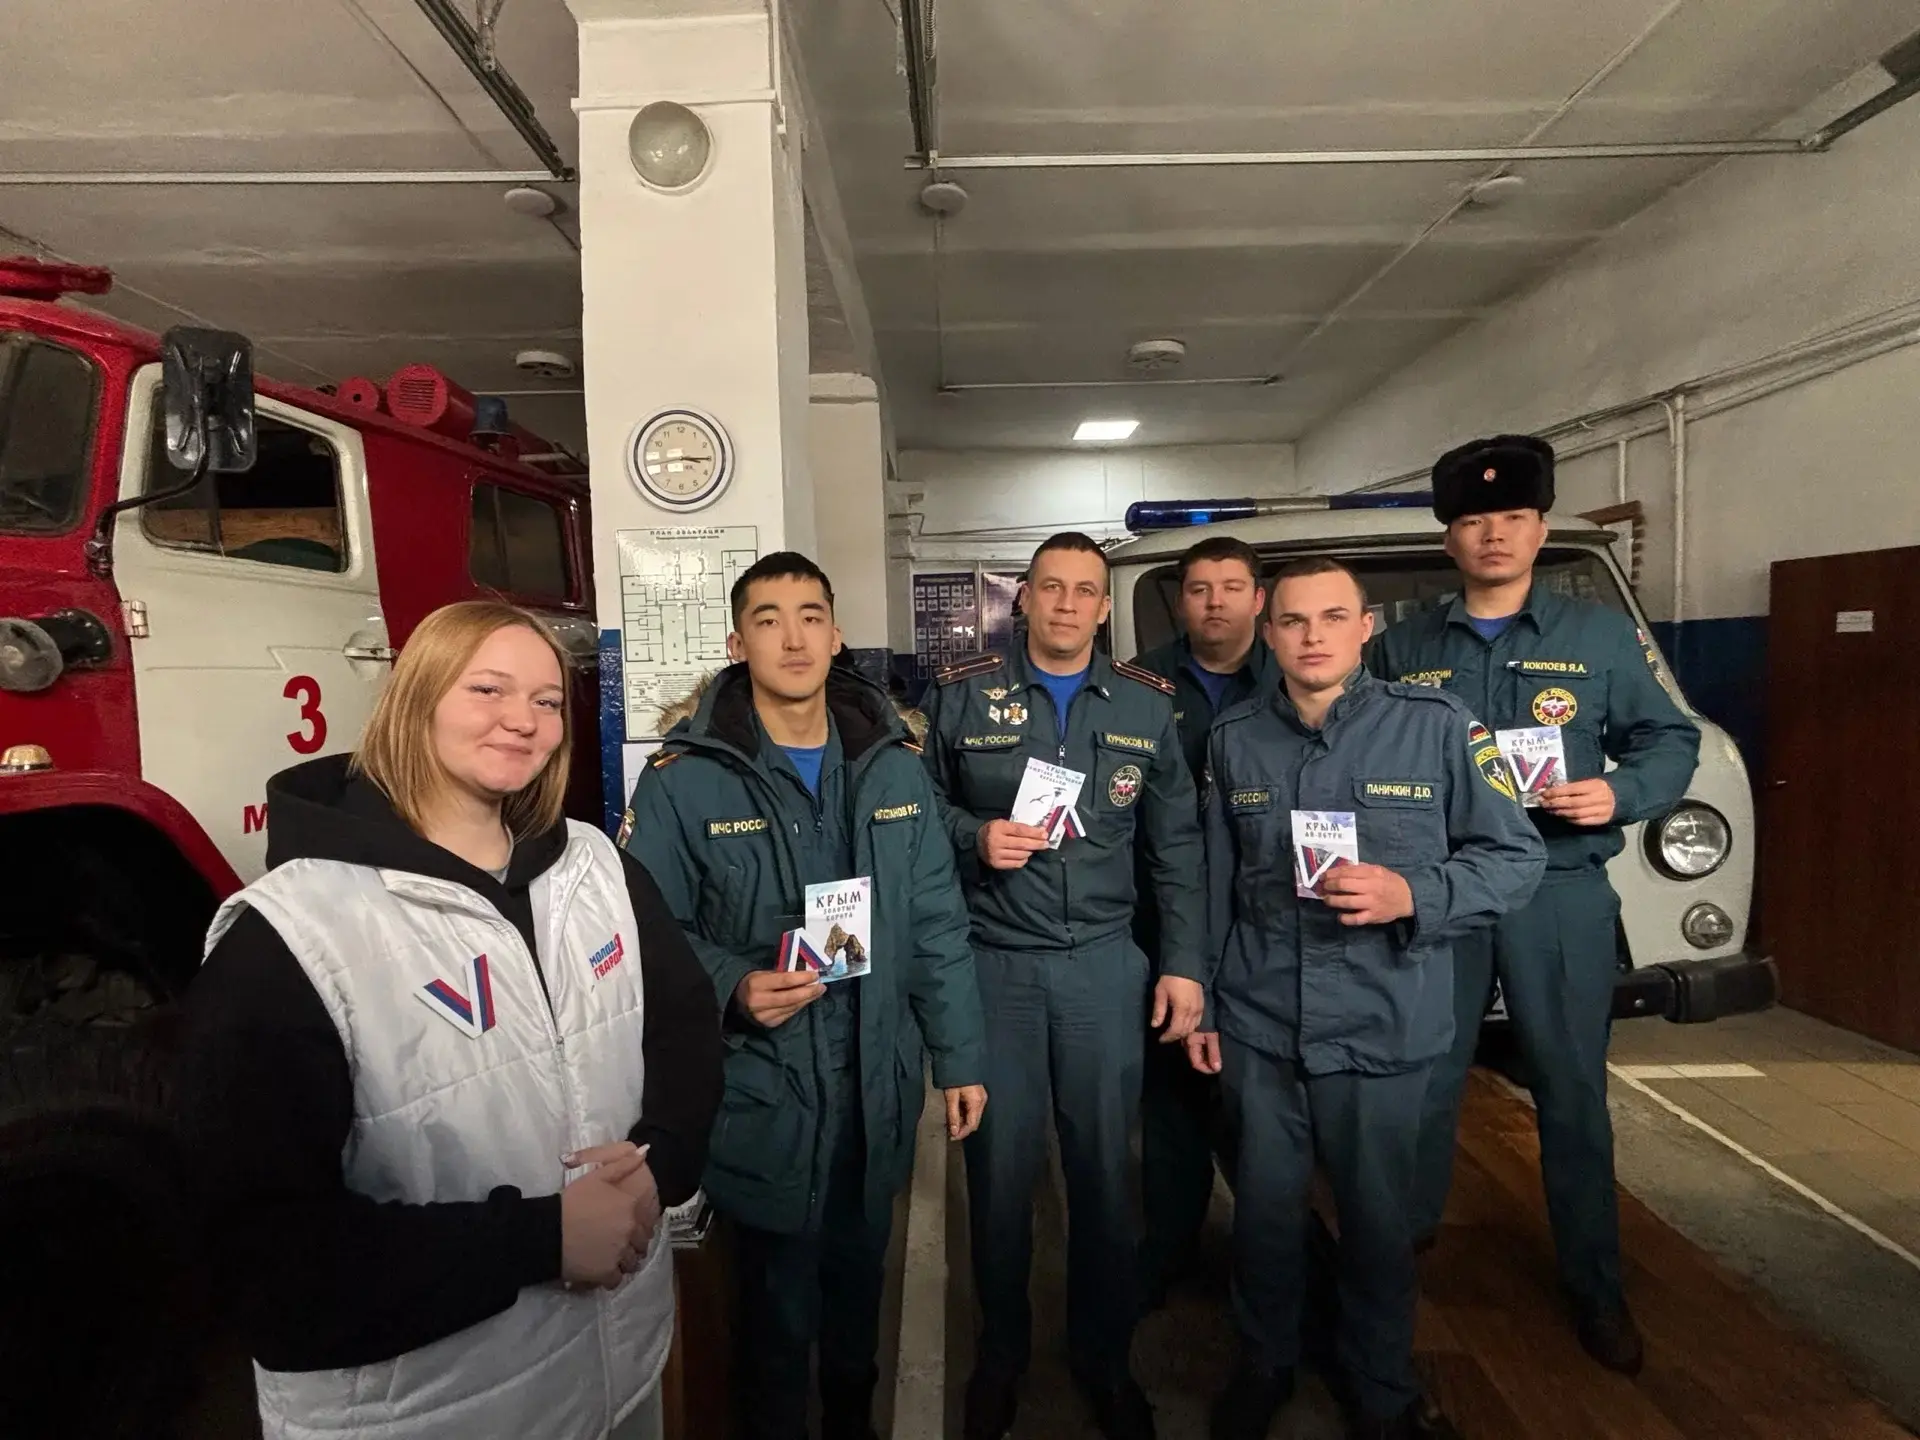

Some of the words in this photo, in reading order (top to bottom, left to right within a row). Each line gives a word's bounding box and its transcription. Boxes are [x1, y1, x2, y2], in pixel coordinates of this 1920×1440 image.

[283, 675, 327, 755] 3
[1511, 737, 1545, 747] КРЫМ
[1366, 783, 1411, 797] ПАНИЧКИН
[710, 822, 732, 835] МЧС
[1305, 821, 1340, 831] КРЫМ
[816, 890, 861, 908] КРЫМ
